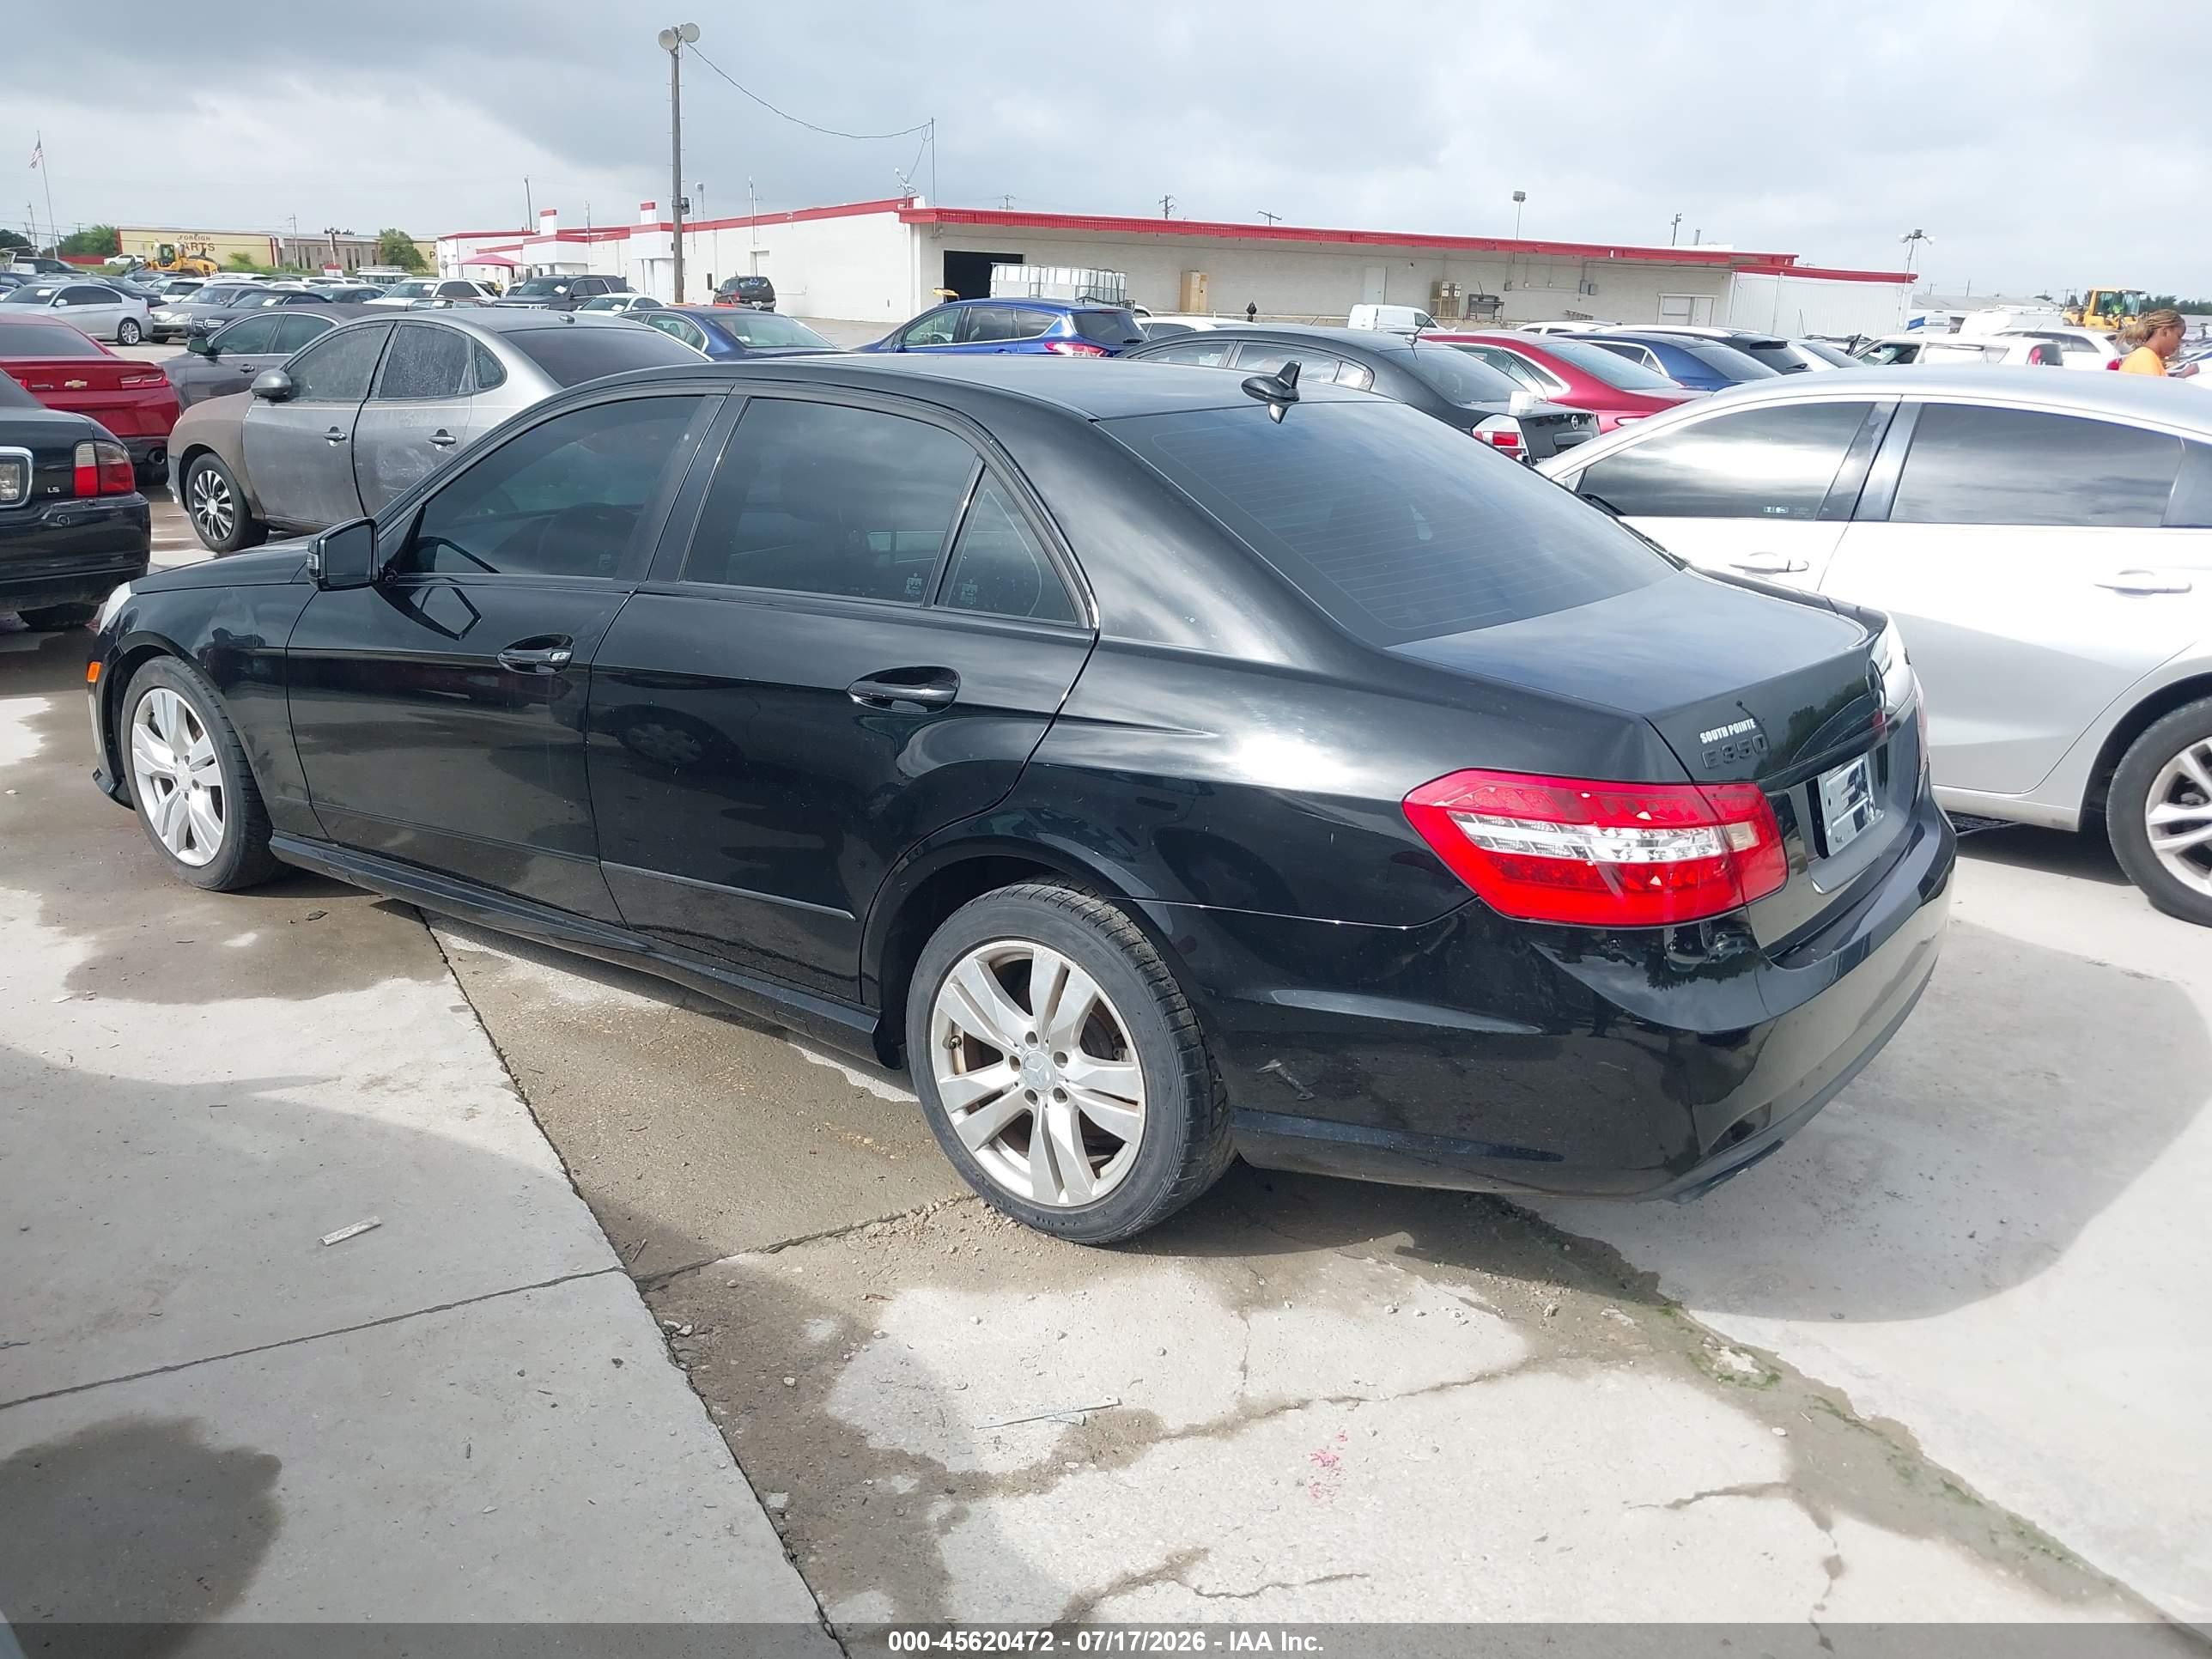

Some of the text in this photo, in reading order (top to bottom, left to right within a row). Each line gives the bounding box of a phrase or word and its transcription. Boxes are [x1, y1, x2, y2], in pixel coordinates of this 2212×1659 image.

[1700, 718, 1756, 744] SOUTH POINTE
[1702, 734, 1769, 769] E350
